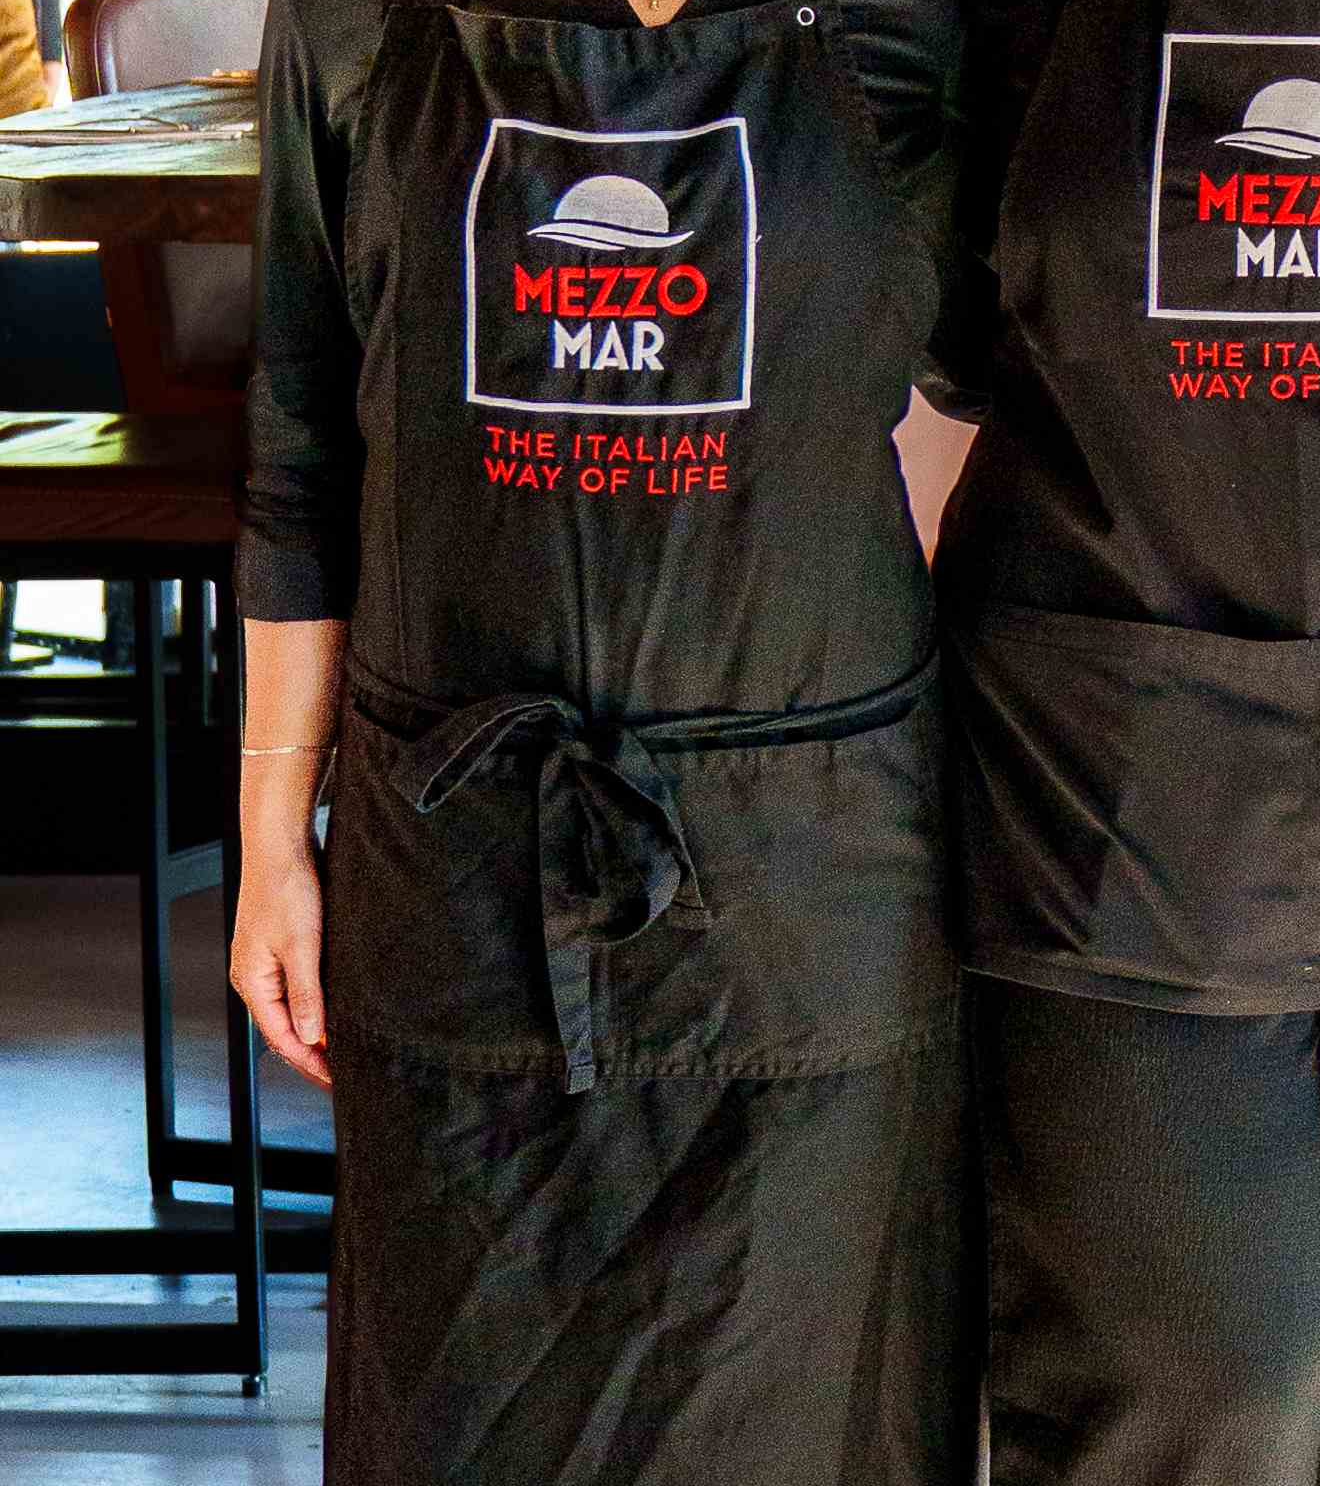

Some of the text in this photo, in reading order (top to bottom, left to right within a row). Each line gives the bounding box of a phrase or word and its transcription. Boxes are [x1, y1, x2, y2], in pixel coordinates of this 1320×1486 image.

[513, 263, 708, 318] MEZZO
[552, 320, 665, 370] MAR
[1171, 339, 1245, 368] THE
[1169, 372, 1253, 400] WAY
[1269, 373, 1320, 400] OF
[486, 426, 727, 462] THE ITALIAN
[484, 456, 729, 494] WAY OF LIFE
